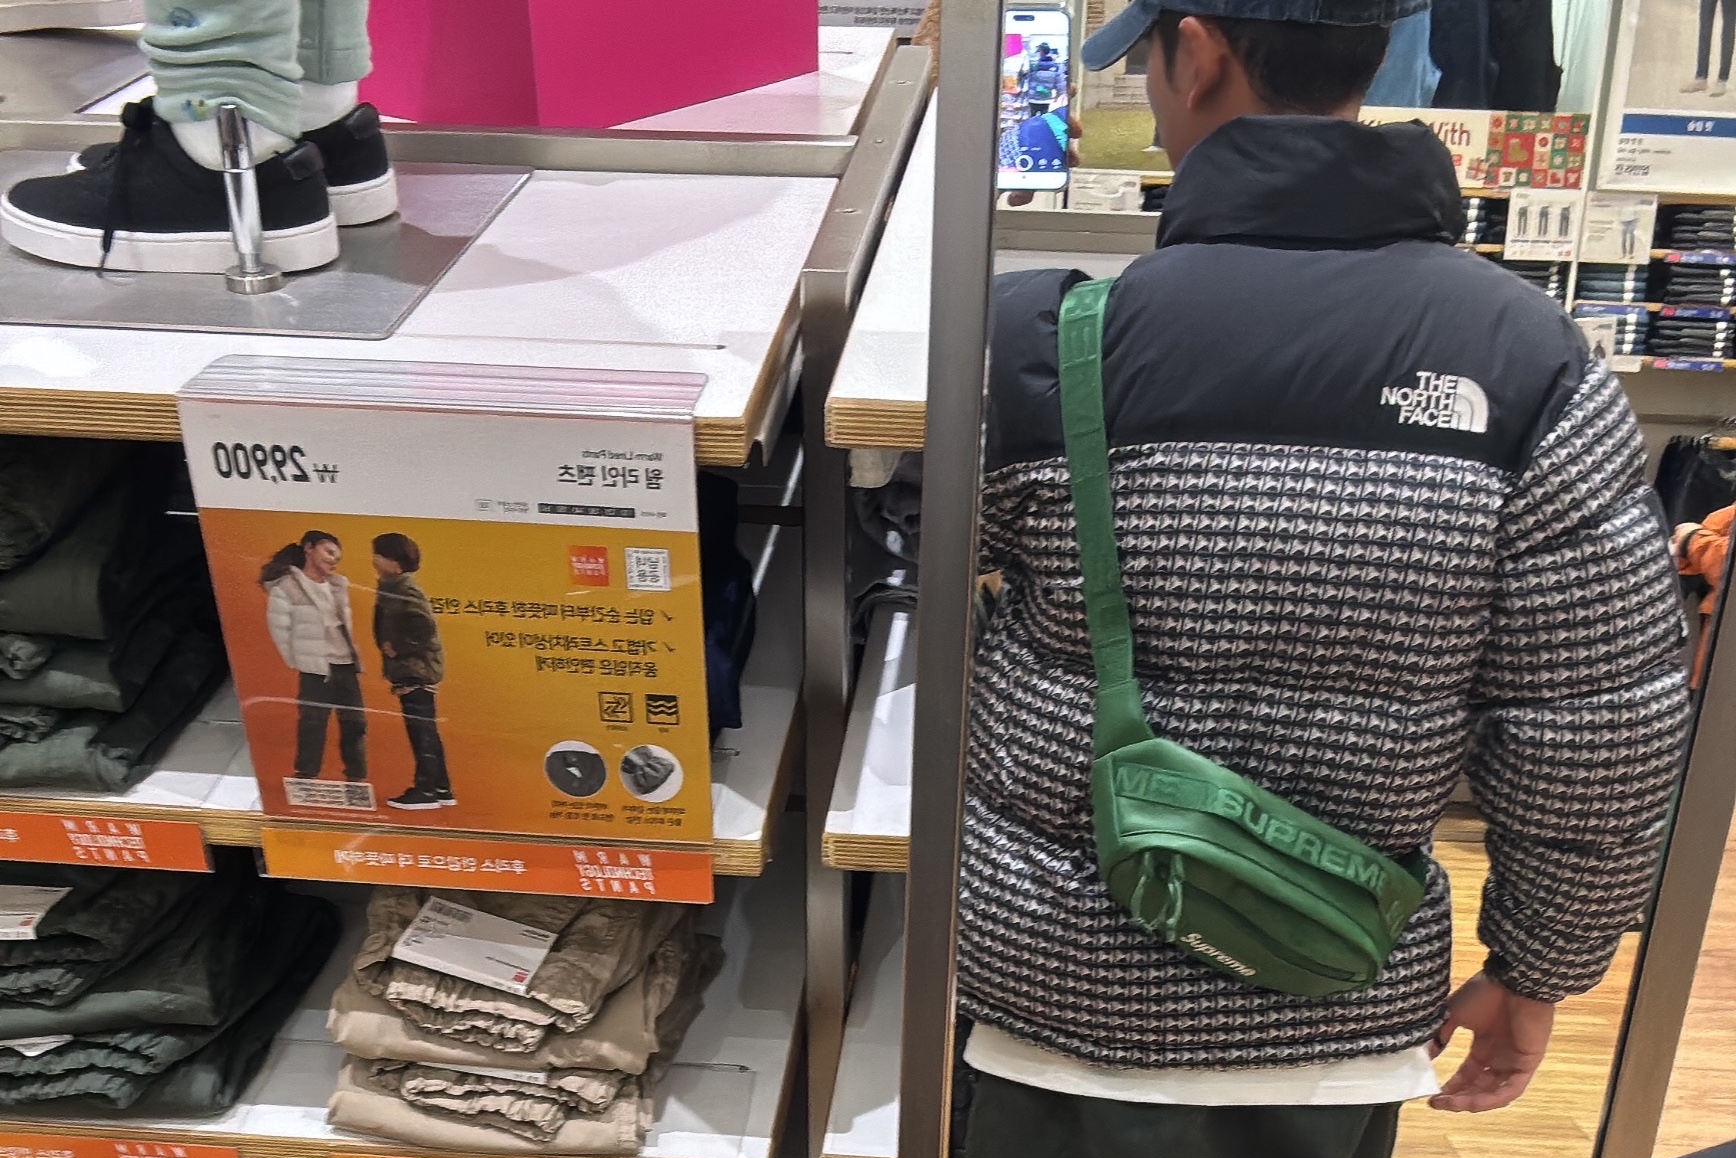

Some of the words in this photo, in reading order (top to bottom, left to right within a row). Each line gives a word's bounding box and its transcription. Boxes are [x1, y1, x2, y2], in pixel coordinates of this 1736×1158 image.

[1416, 371, 1458, 394] THE
[1380, 386, 1455, 411] NORTH
[1398, 406, 1453, 428] FACE
[1180, 933, 1258, 977] Supreme
